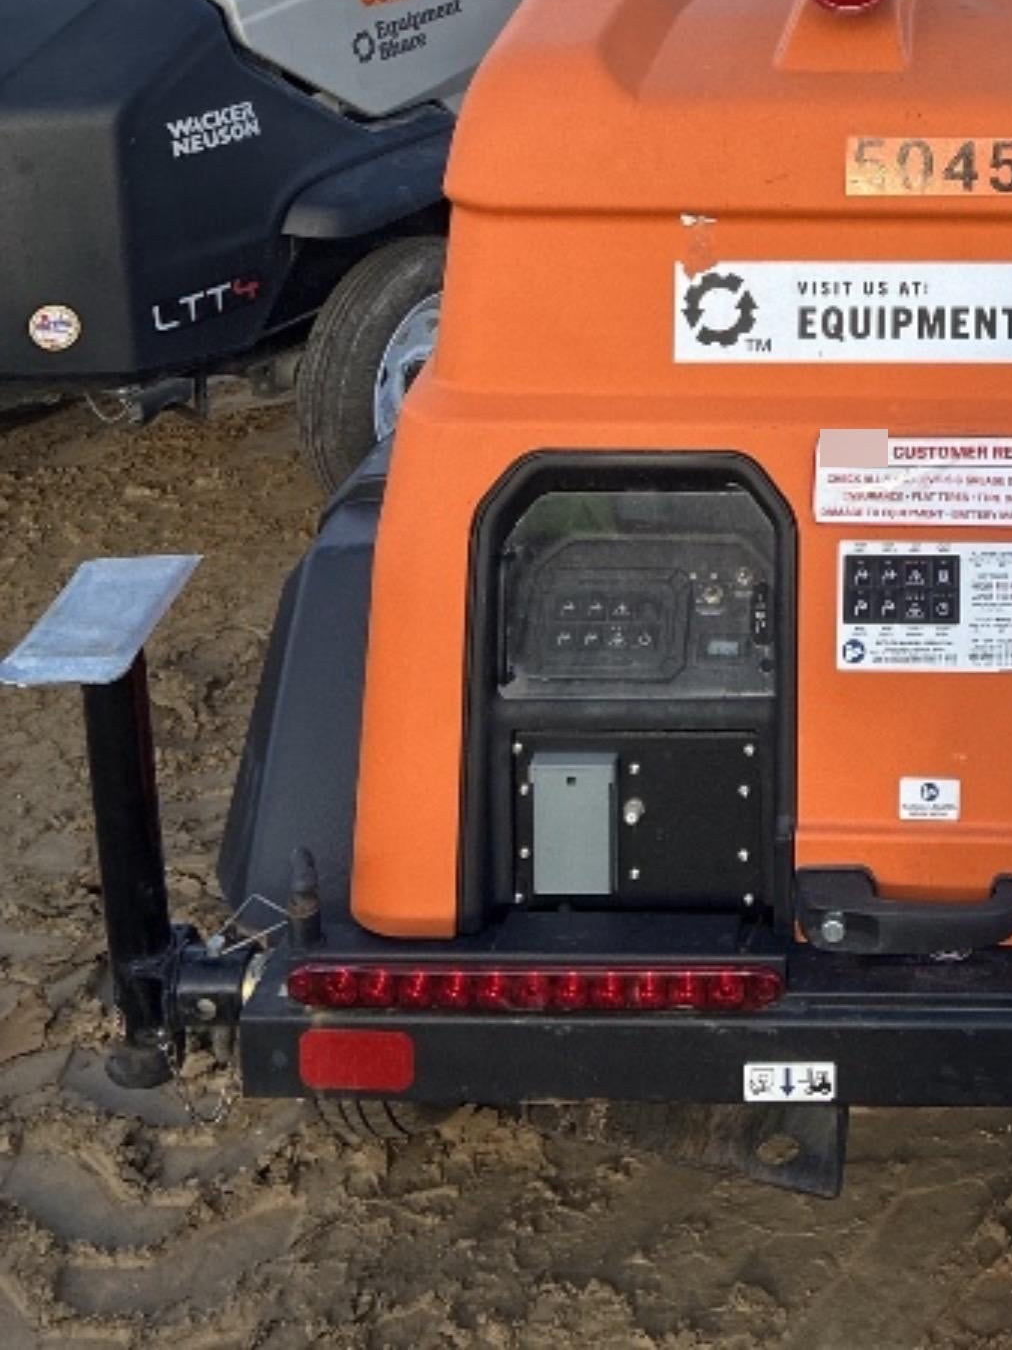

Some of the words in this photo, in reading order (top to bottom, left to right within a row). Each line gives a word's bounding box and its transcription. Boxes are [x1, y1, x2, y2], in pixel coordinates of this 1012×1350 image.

[166, 101, 256, 139] WACKER
[171, 117, 262, 158] NEUSON
[797, 281, 853, 296] VISIT
[862, 281, 889, 296] US
[899, 281, 930, 296] AT:
[746, 338, 772, 352] TM
[892, 446, 988, 460] CUSTOMER
